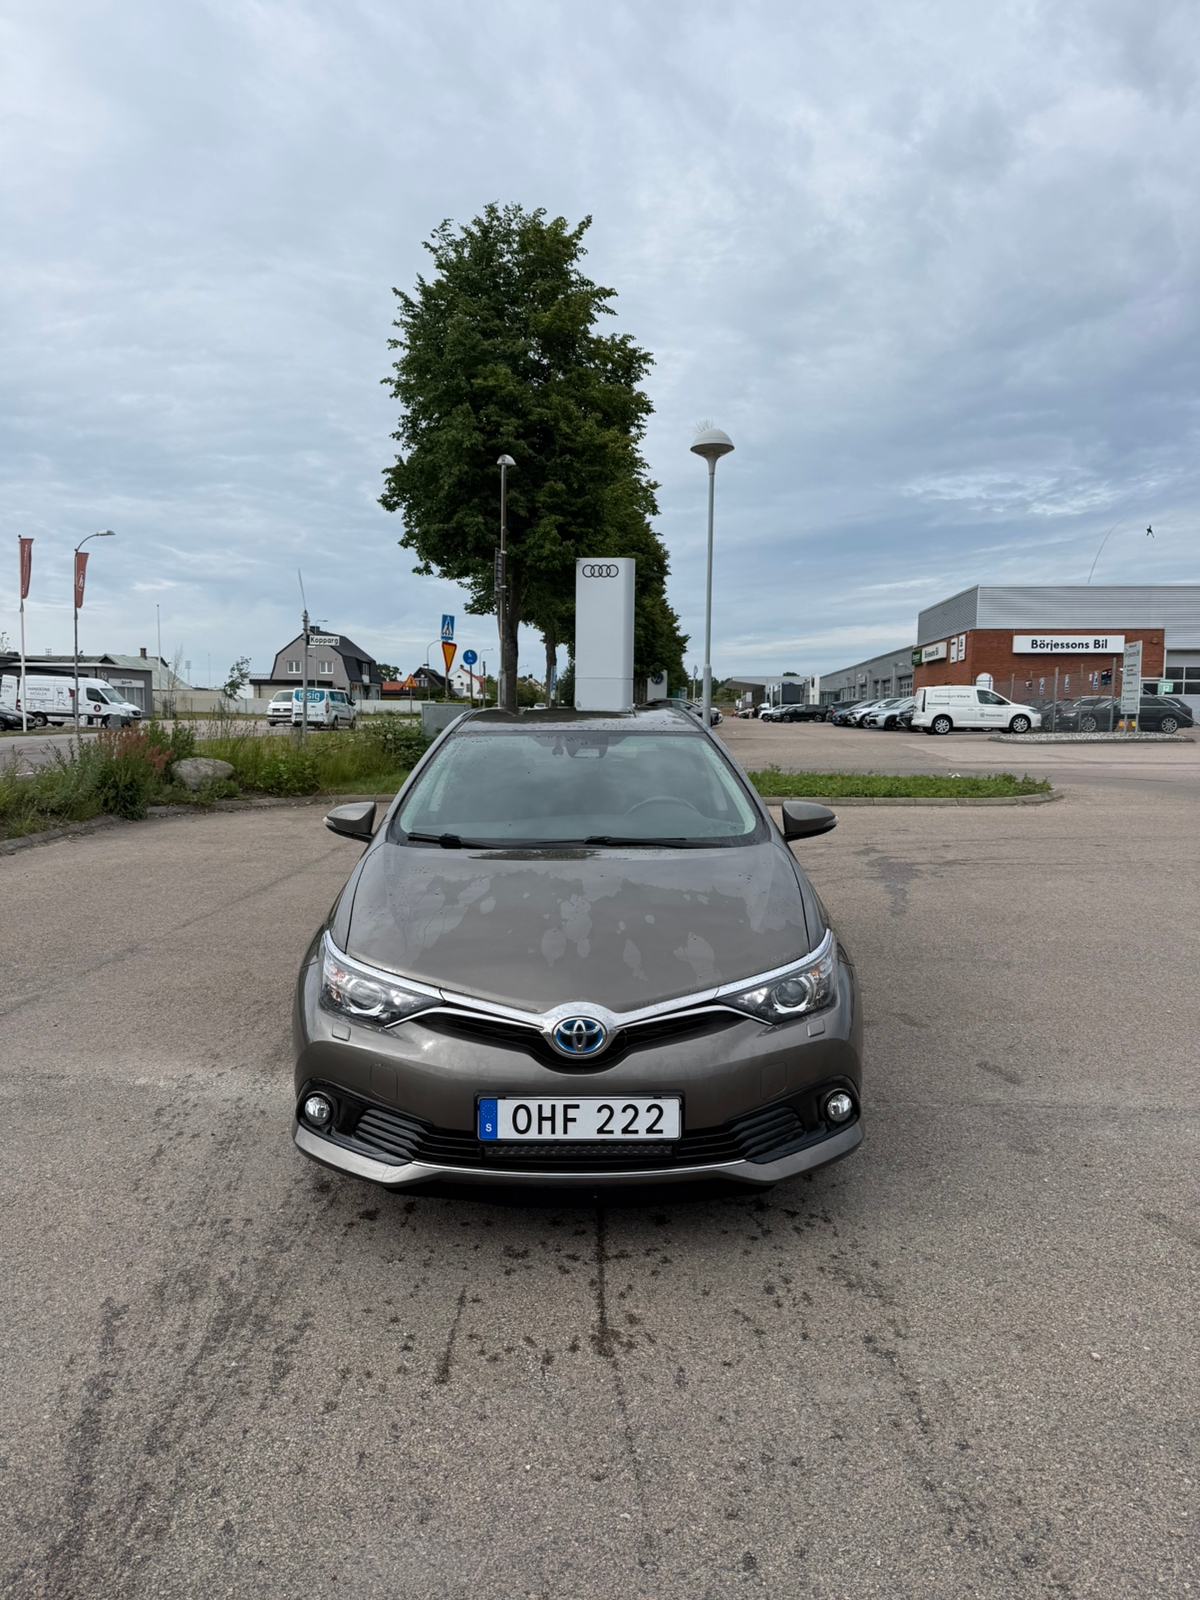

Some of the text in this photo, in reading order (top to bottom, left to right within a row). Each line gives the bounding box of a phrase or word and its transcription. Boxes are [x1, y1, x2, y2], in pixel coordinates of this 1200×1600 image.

[310, 637, 339, 645] Kopparg
[1031, 639, 1108, 651] Börjessons Bil
[512, 1104, 664, 1135] OHF 222
[485, 1123, 493, 1132] S
